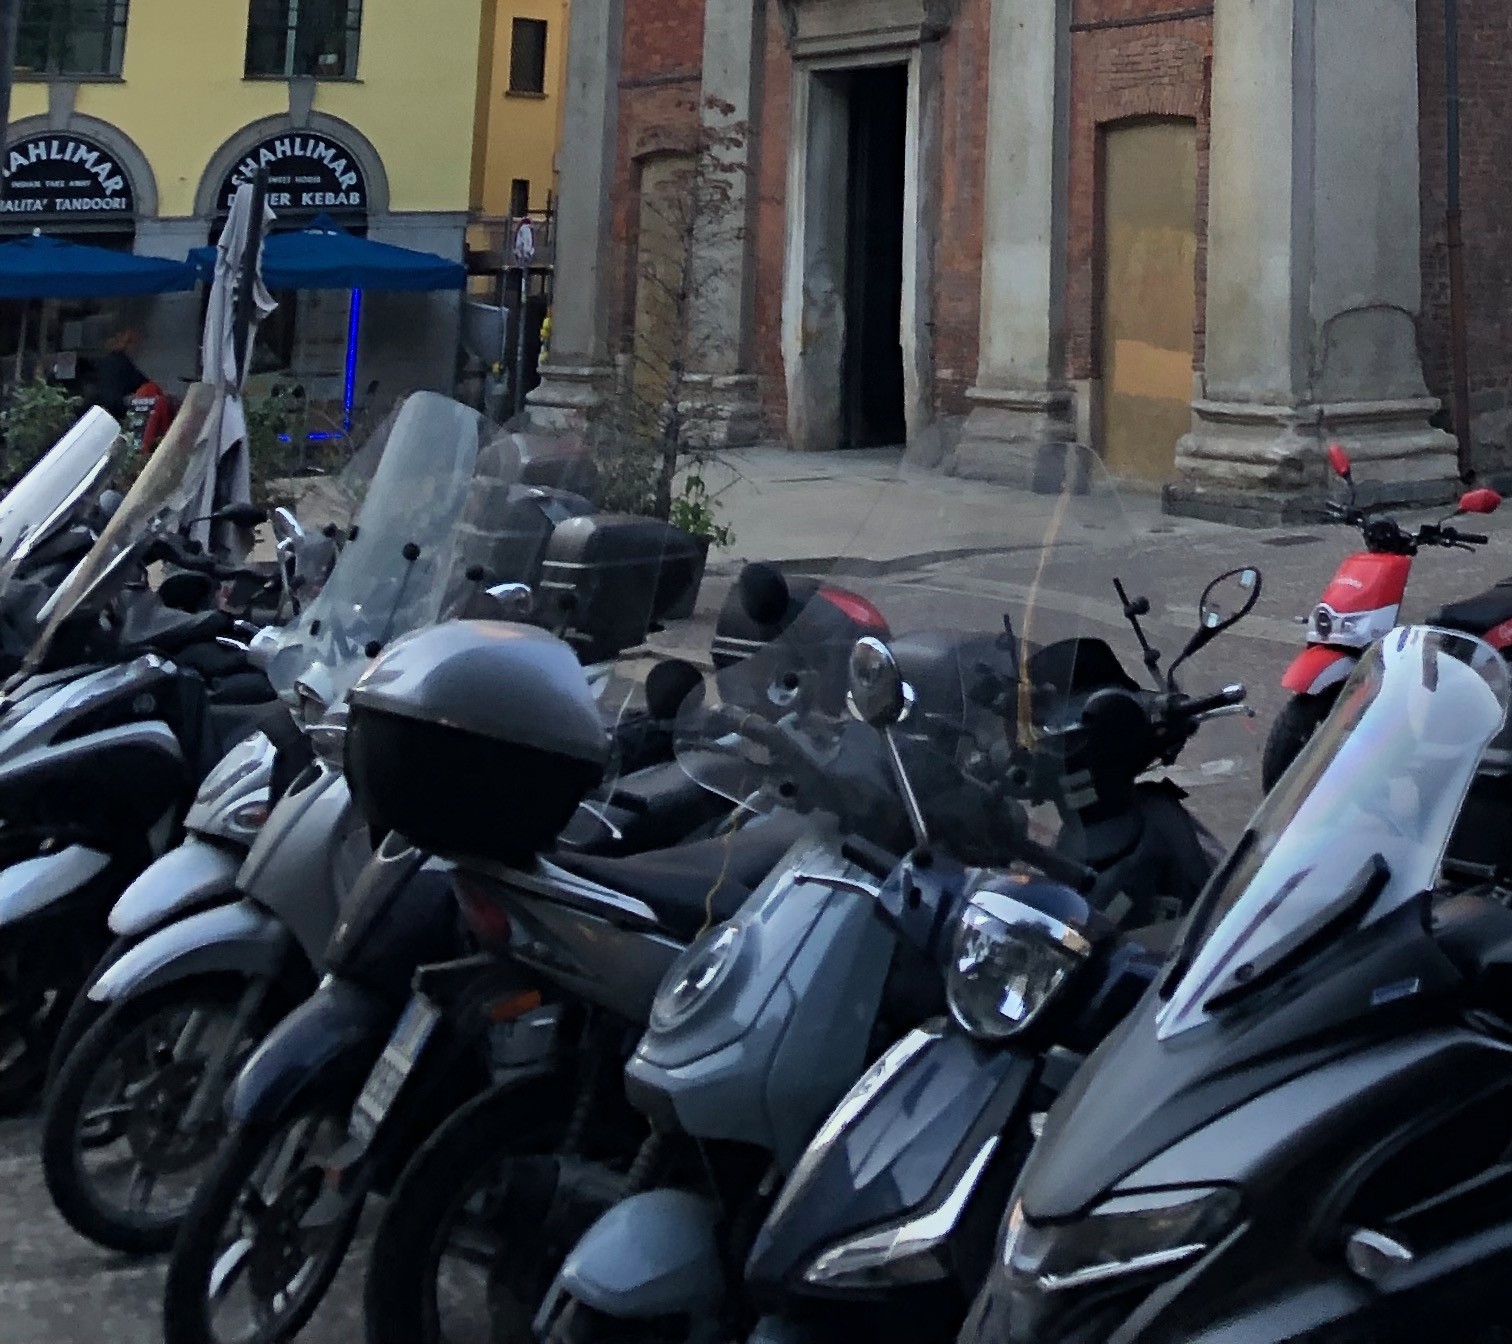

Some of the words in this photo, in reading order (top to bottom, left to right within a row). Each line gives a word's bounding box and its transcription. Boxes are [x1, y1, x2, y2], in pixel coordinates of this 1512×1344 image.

[2, 140, 124, 195] AHLIMAR
[231, 137, 357, 190] SHAHLIMAR
[55, 197, 126, 210] TANDOORI
[301, 192, 360, 206] KEBAB
